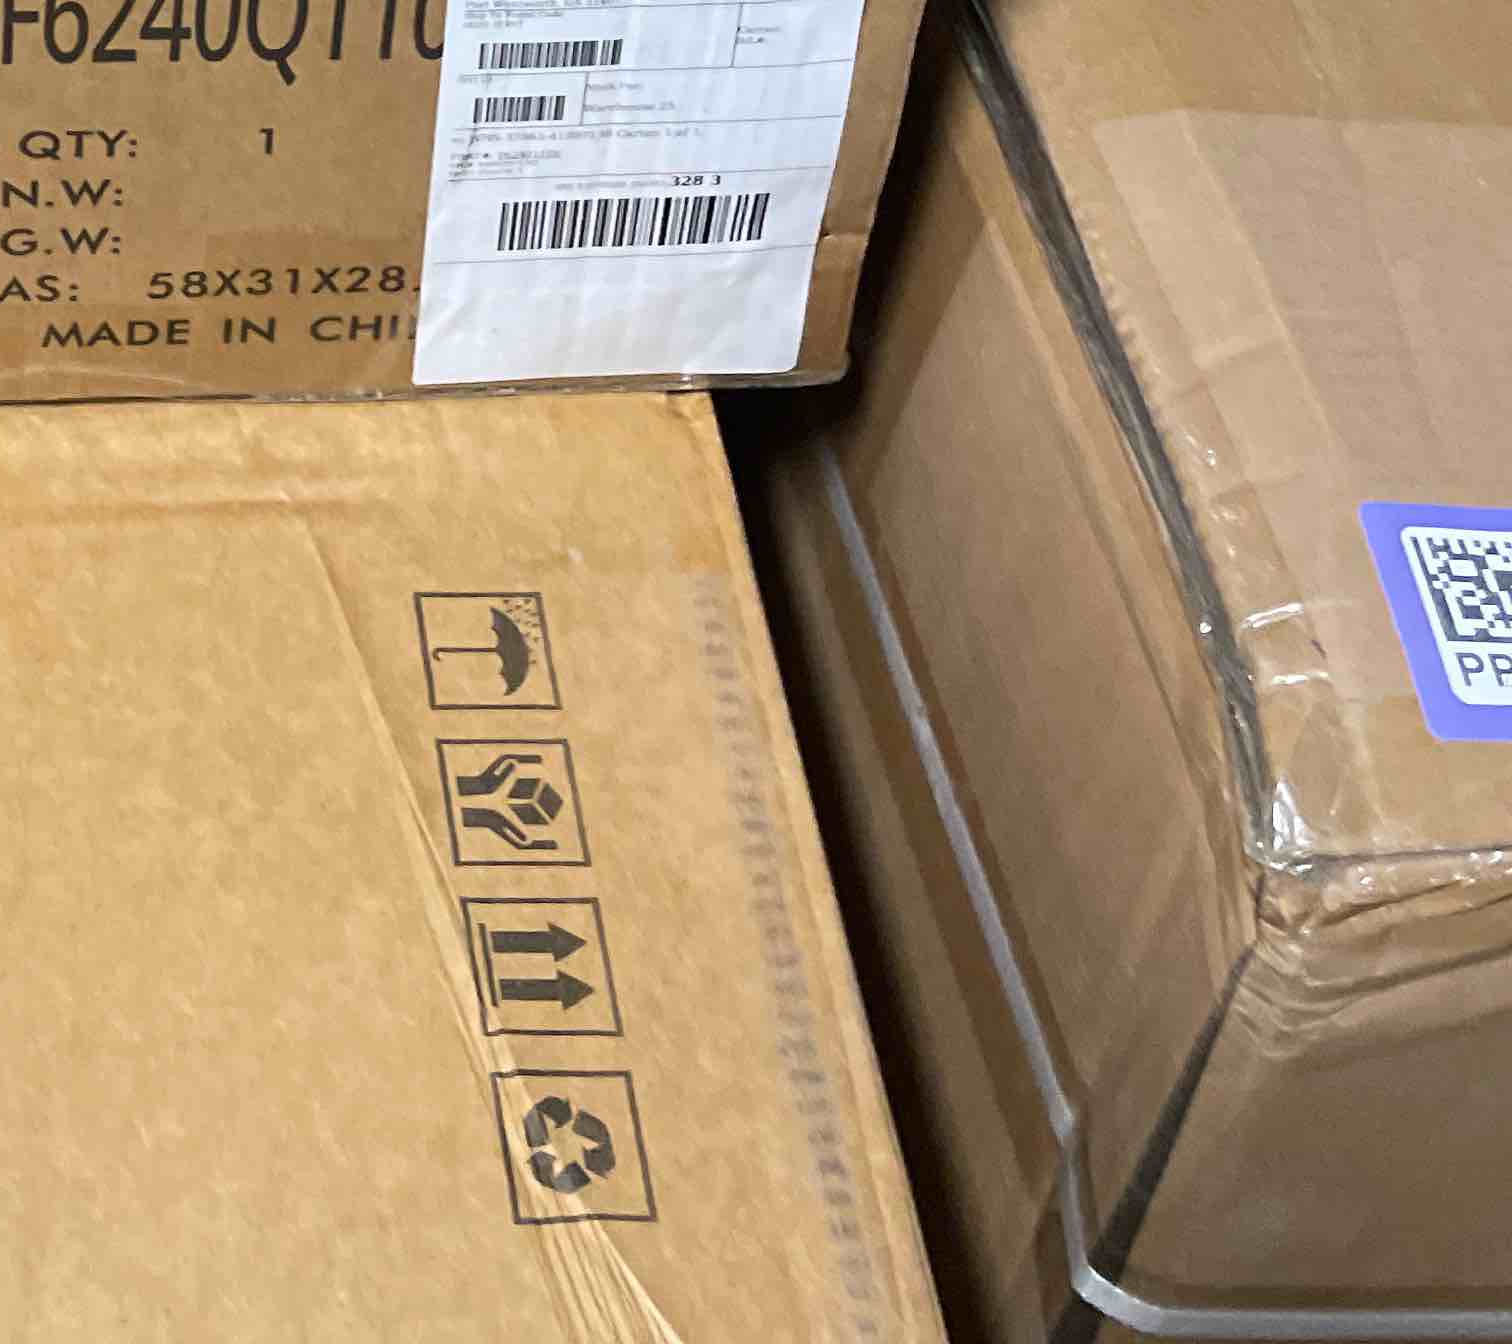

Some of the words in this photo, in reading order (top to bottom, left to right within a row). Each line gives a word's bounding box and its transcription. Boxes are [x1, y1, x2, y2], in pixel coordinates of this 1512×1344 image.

[18, 127, 139, 162] QTY:
[259, 127, 275, 155] 1
[2, 176, 124, 209] N.W:
[671, 174, 704, 187] 328
[712, 174, 722, 186] 3
[0, 226, 122, 258] G.W:
[43, 317, 191, 350] MADE
[222, 315, 279, 345] IN
[310, 312, 416, 343] CHI
